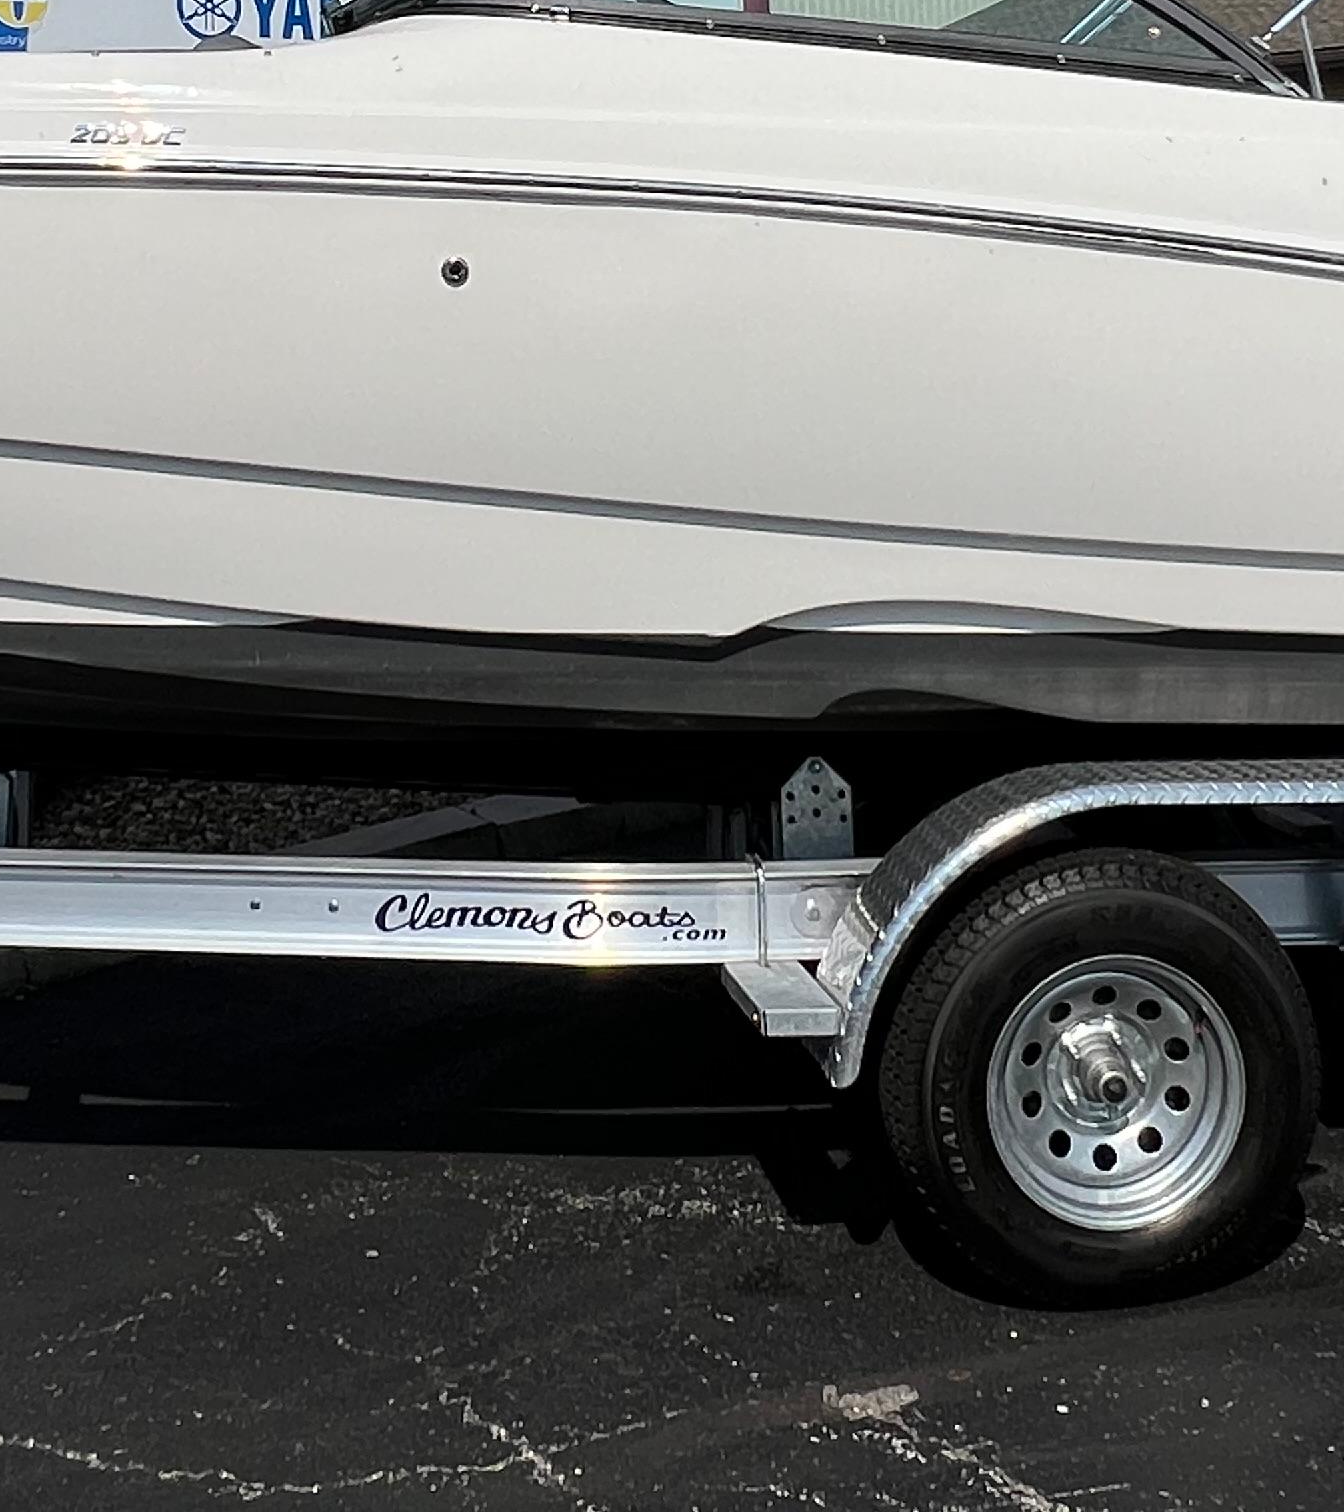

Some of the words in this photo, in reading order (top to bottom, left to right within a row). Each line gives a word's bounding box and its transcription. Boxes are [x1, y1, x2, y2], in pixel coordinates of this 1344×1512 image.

[374, 892, 557, 935] Clemons
[562, 899, 696, 940] Boats
[661, 928, 728, 942] .com
